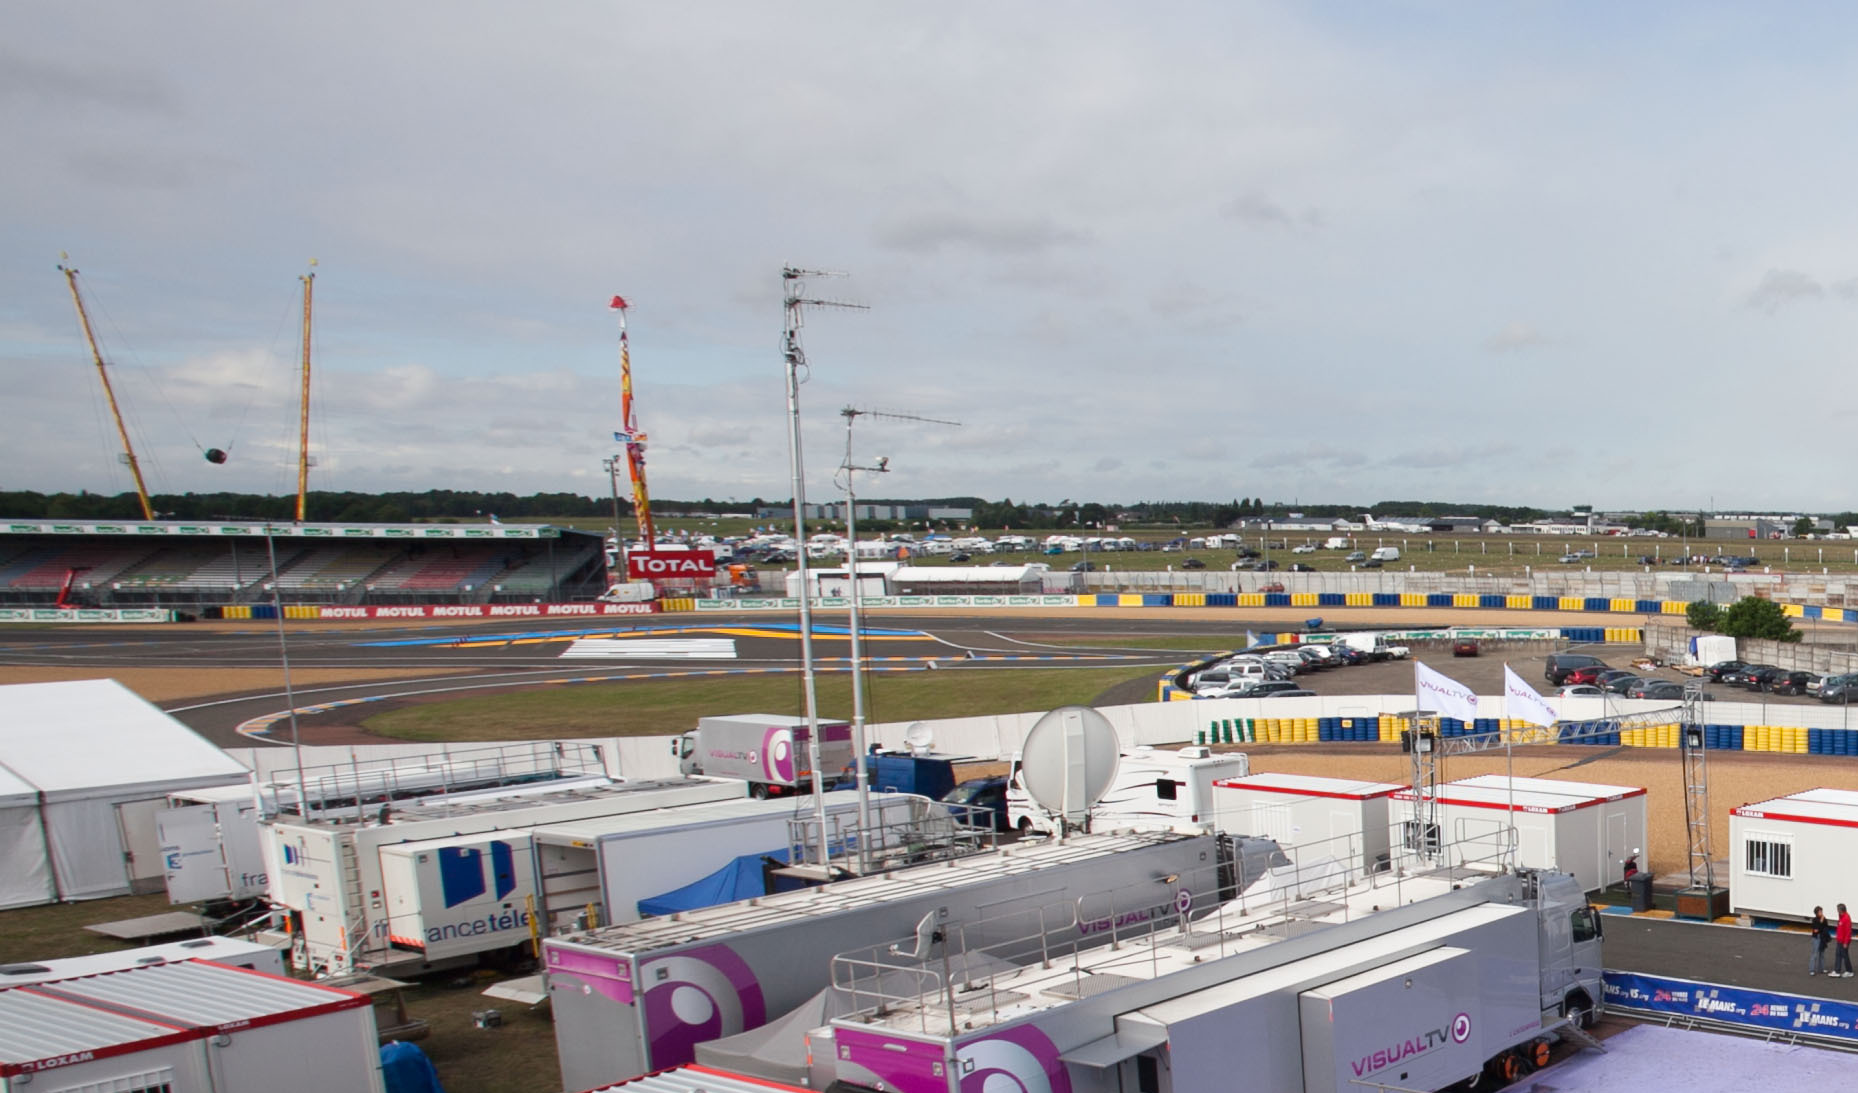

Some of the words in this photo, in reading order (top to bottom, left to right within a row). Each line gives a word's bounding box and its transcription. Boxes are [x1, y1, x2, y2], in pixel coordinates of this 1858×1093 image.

[631, 555, 714, 572] TOTAL
[321, 607, 368, 617] MOTUL
[376, 607, 425, 617] MOTUL
[433, 606, 483, 616] MOTUL
[490, 605, 540, 615] MOTUL
[547, 604, 596, 614] MOTUL
[604, 603, 652, 614] MOTUL
[1654, 990, 1671, 1002] 24
[1698, 999, 1709, 1010] LE
[1751, 1004, 1768, 1016] 24
[1800, 1012, 1810, 1023] LE
[1352, 1025, 1450, 1077] VISUALTV
[37, 1051, 94, 1071] LOXAM
